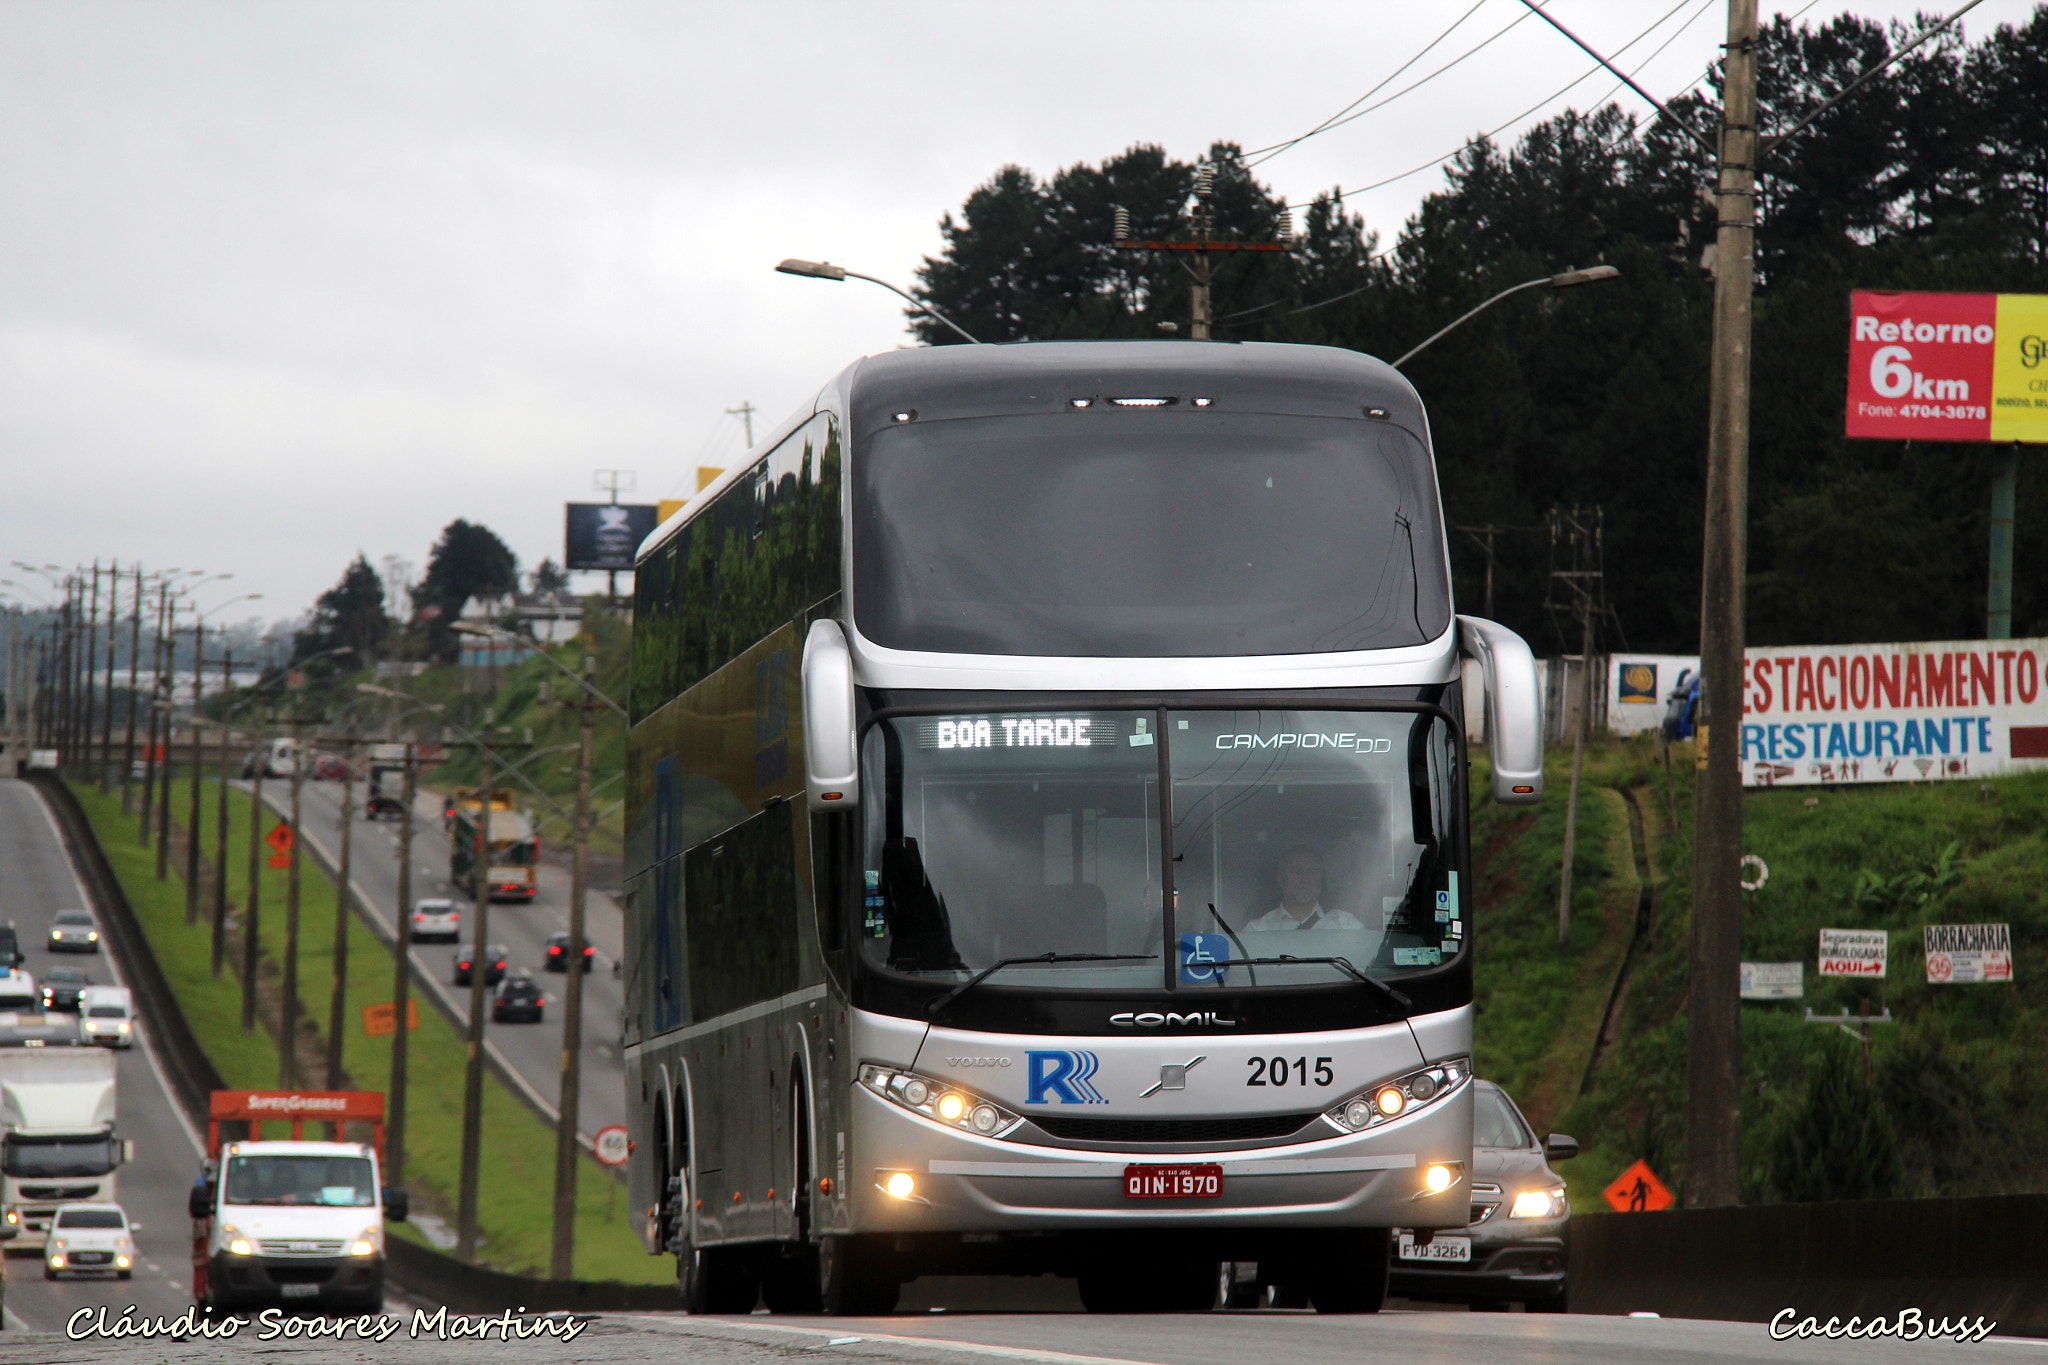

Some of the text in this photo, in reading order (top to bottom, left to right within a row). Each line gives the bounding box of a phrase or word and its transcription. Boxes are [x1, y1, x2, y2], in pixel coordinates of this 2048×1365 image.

[1856, 316, 1994, 344] Retorno
[1859, 403, 1987, 419] Fone: 4704-3678
[938, 718, 1091, 748] BOA TARDE
[1215, 733, 1356, 749] CAMPIONE
[1743, 717, 1992, 761] RESTAURANTE
[1822, 931, 1884, 947] Seguradoras
[1926, 926, 2009, 952] BORRACHARIA
[1824, 960, 1863, 972] AQUI
[1109, 1012, 1236, 1026] COMIL
[945, 1056, 1012, 1068] VOLVO
[1246, 1056, 1334, 1087] 2015
